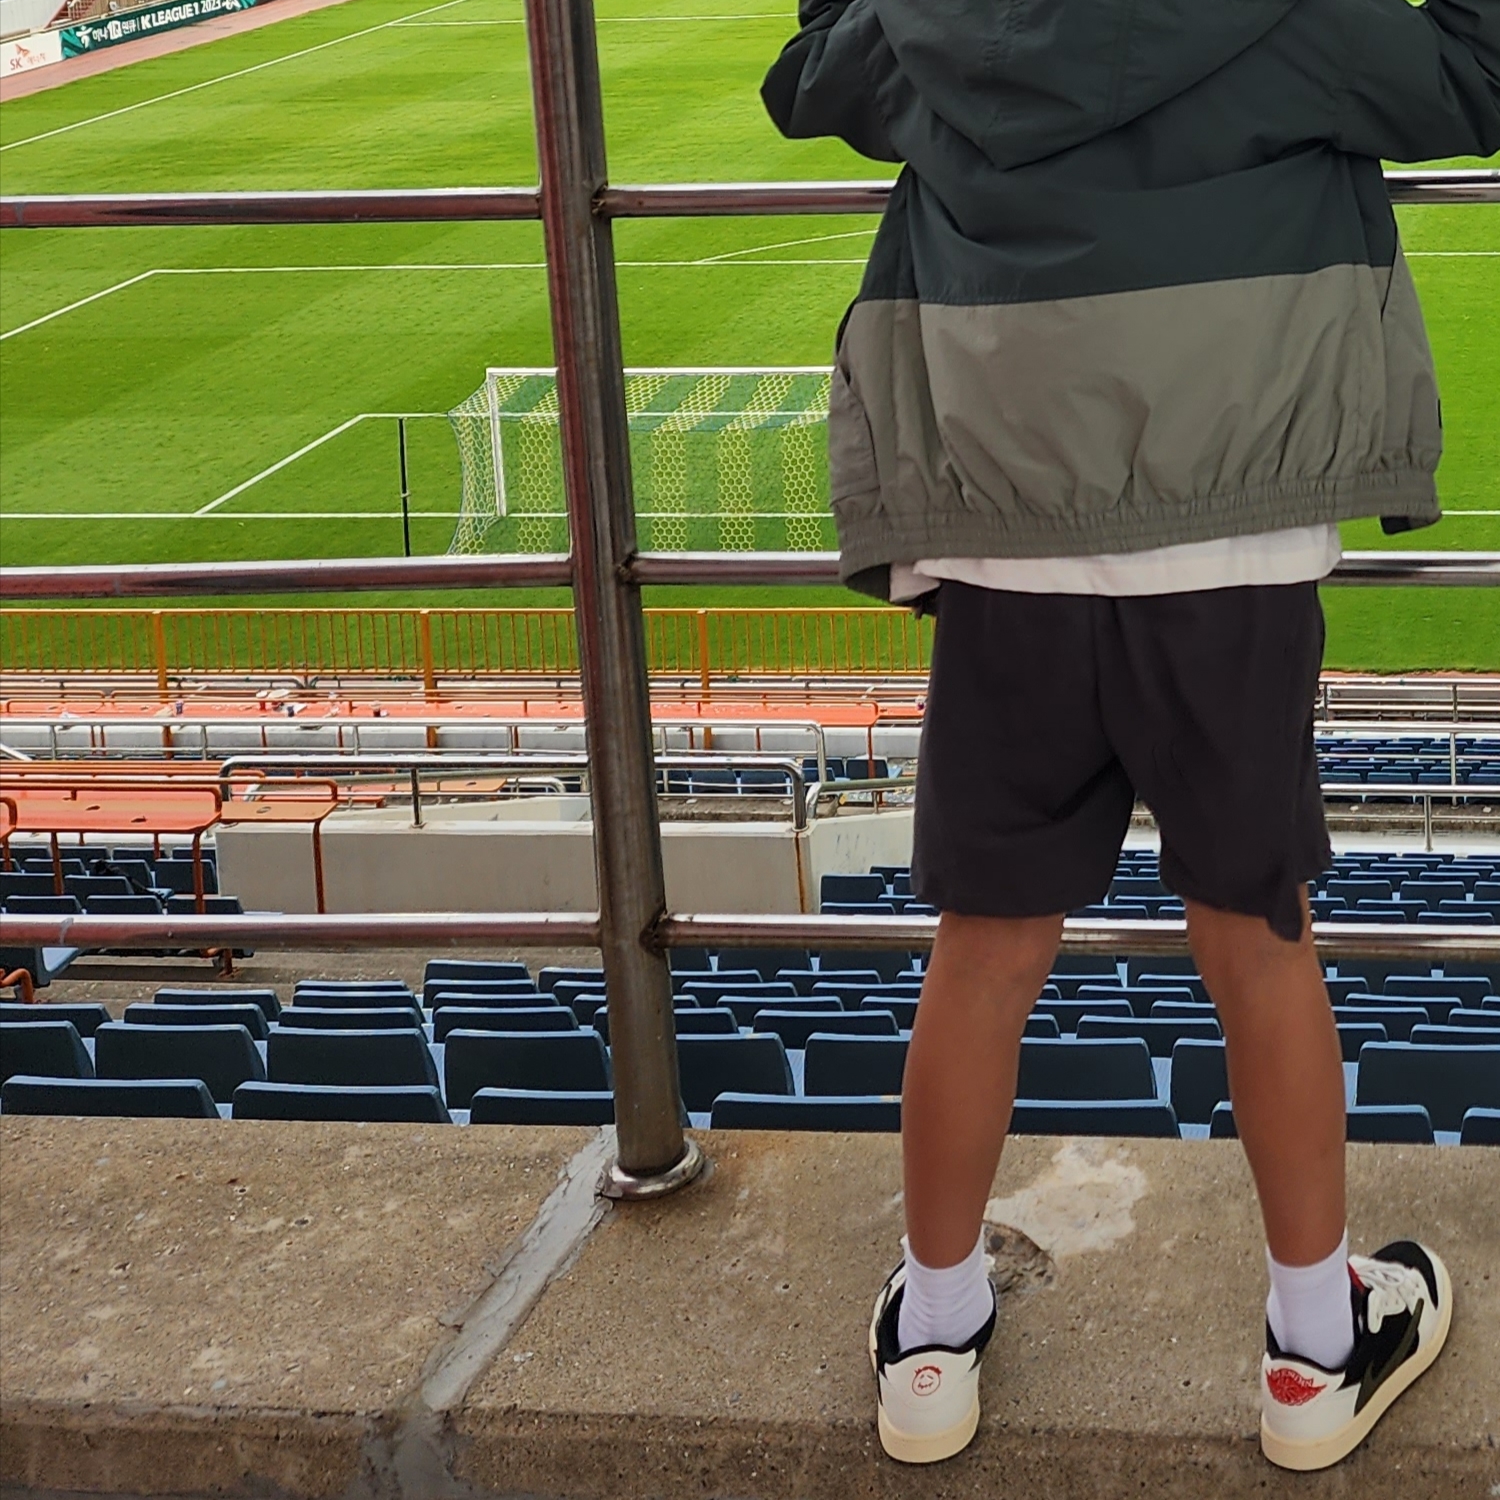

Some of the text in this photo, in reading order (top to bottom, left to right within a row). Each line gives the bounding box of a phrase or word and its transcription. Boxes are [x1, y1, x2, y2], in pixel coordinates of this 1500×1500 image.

[141, 14, 152, 30] K
[151, 3, 194, 27] LEAGUE
[10, 57, 23, 71] SK
